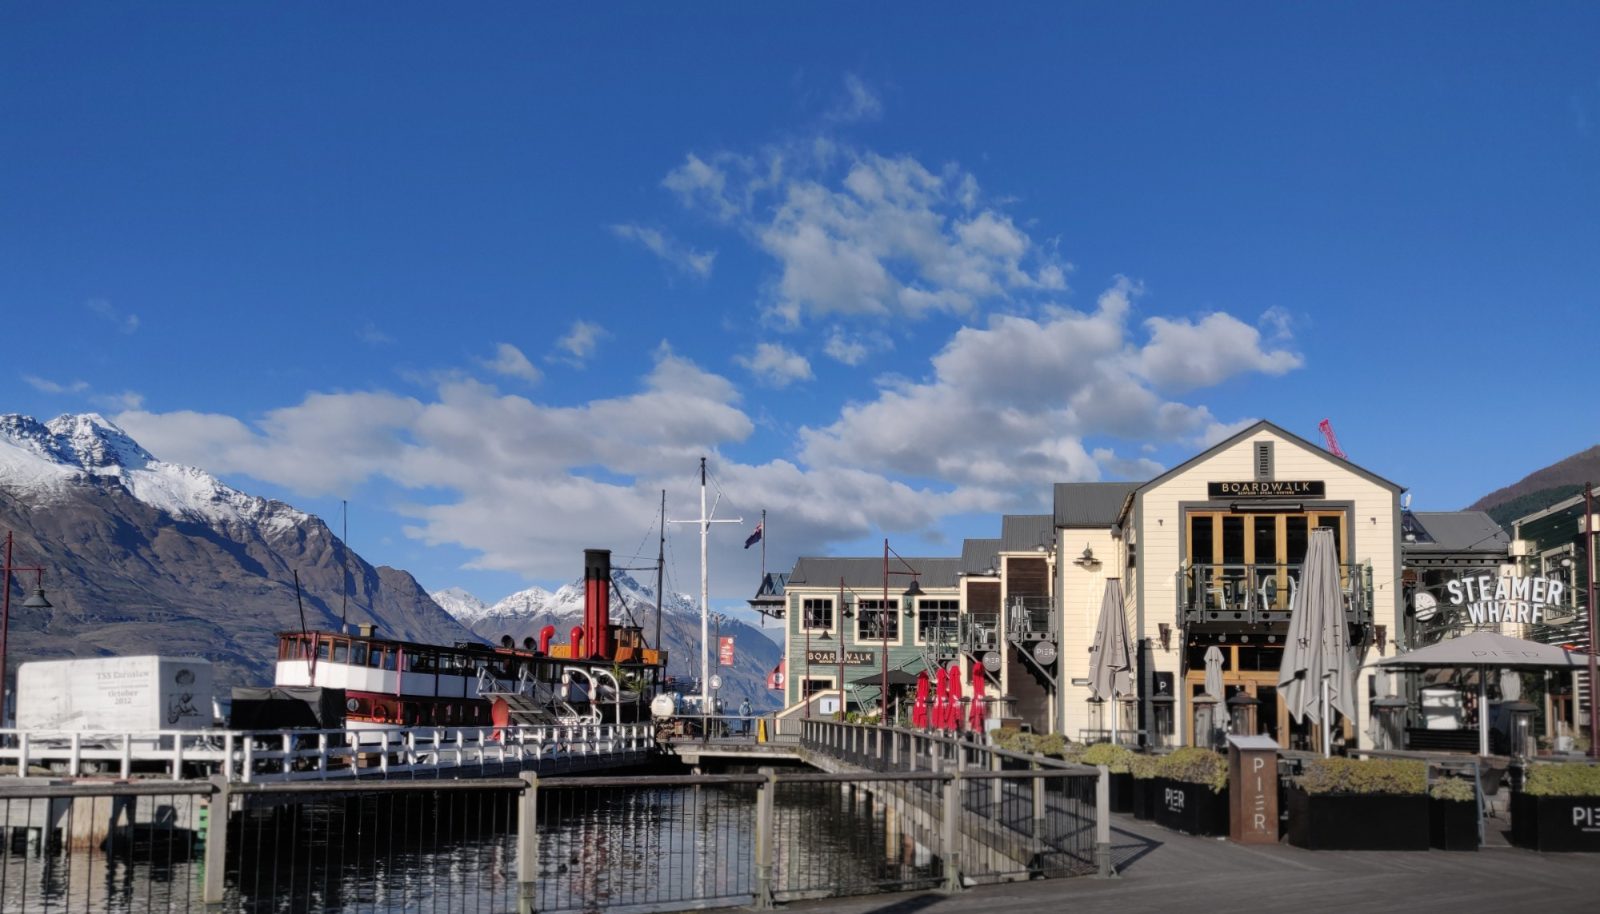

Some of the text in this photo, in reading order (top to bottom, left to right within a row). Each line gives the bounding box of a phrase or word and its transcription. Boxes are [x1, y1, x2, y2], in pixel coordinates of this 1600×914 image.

[1221, 482, 1310, 492] BOARDWALK
[1447, 575, 1563, 605] STEAMER
[1467, 601, 1544, 624] WHARF
[808, 652, 872, 660] BOARWALK
[1036, 648, 1055, 656] PIER
[1164, 787, 1185, 809] PIER
[1252, 757, 1266, 830] PIER
